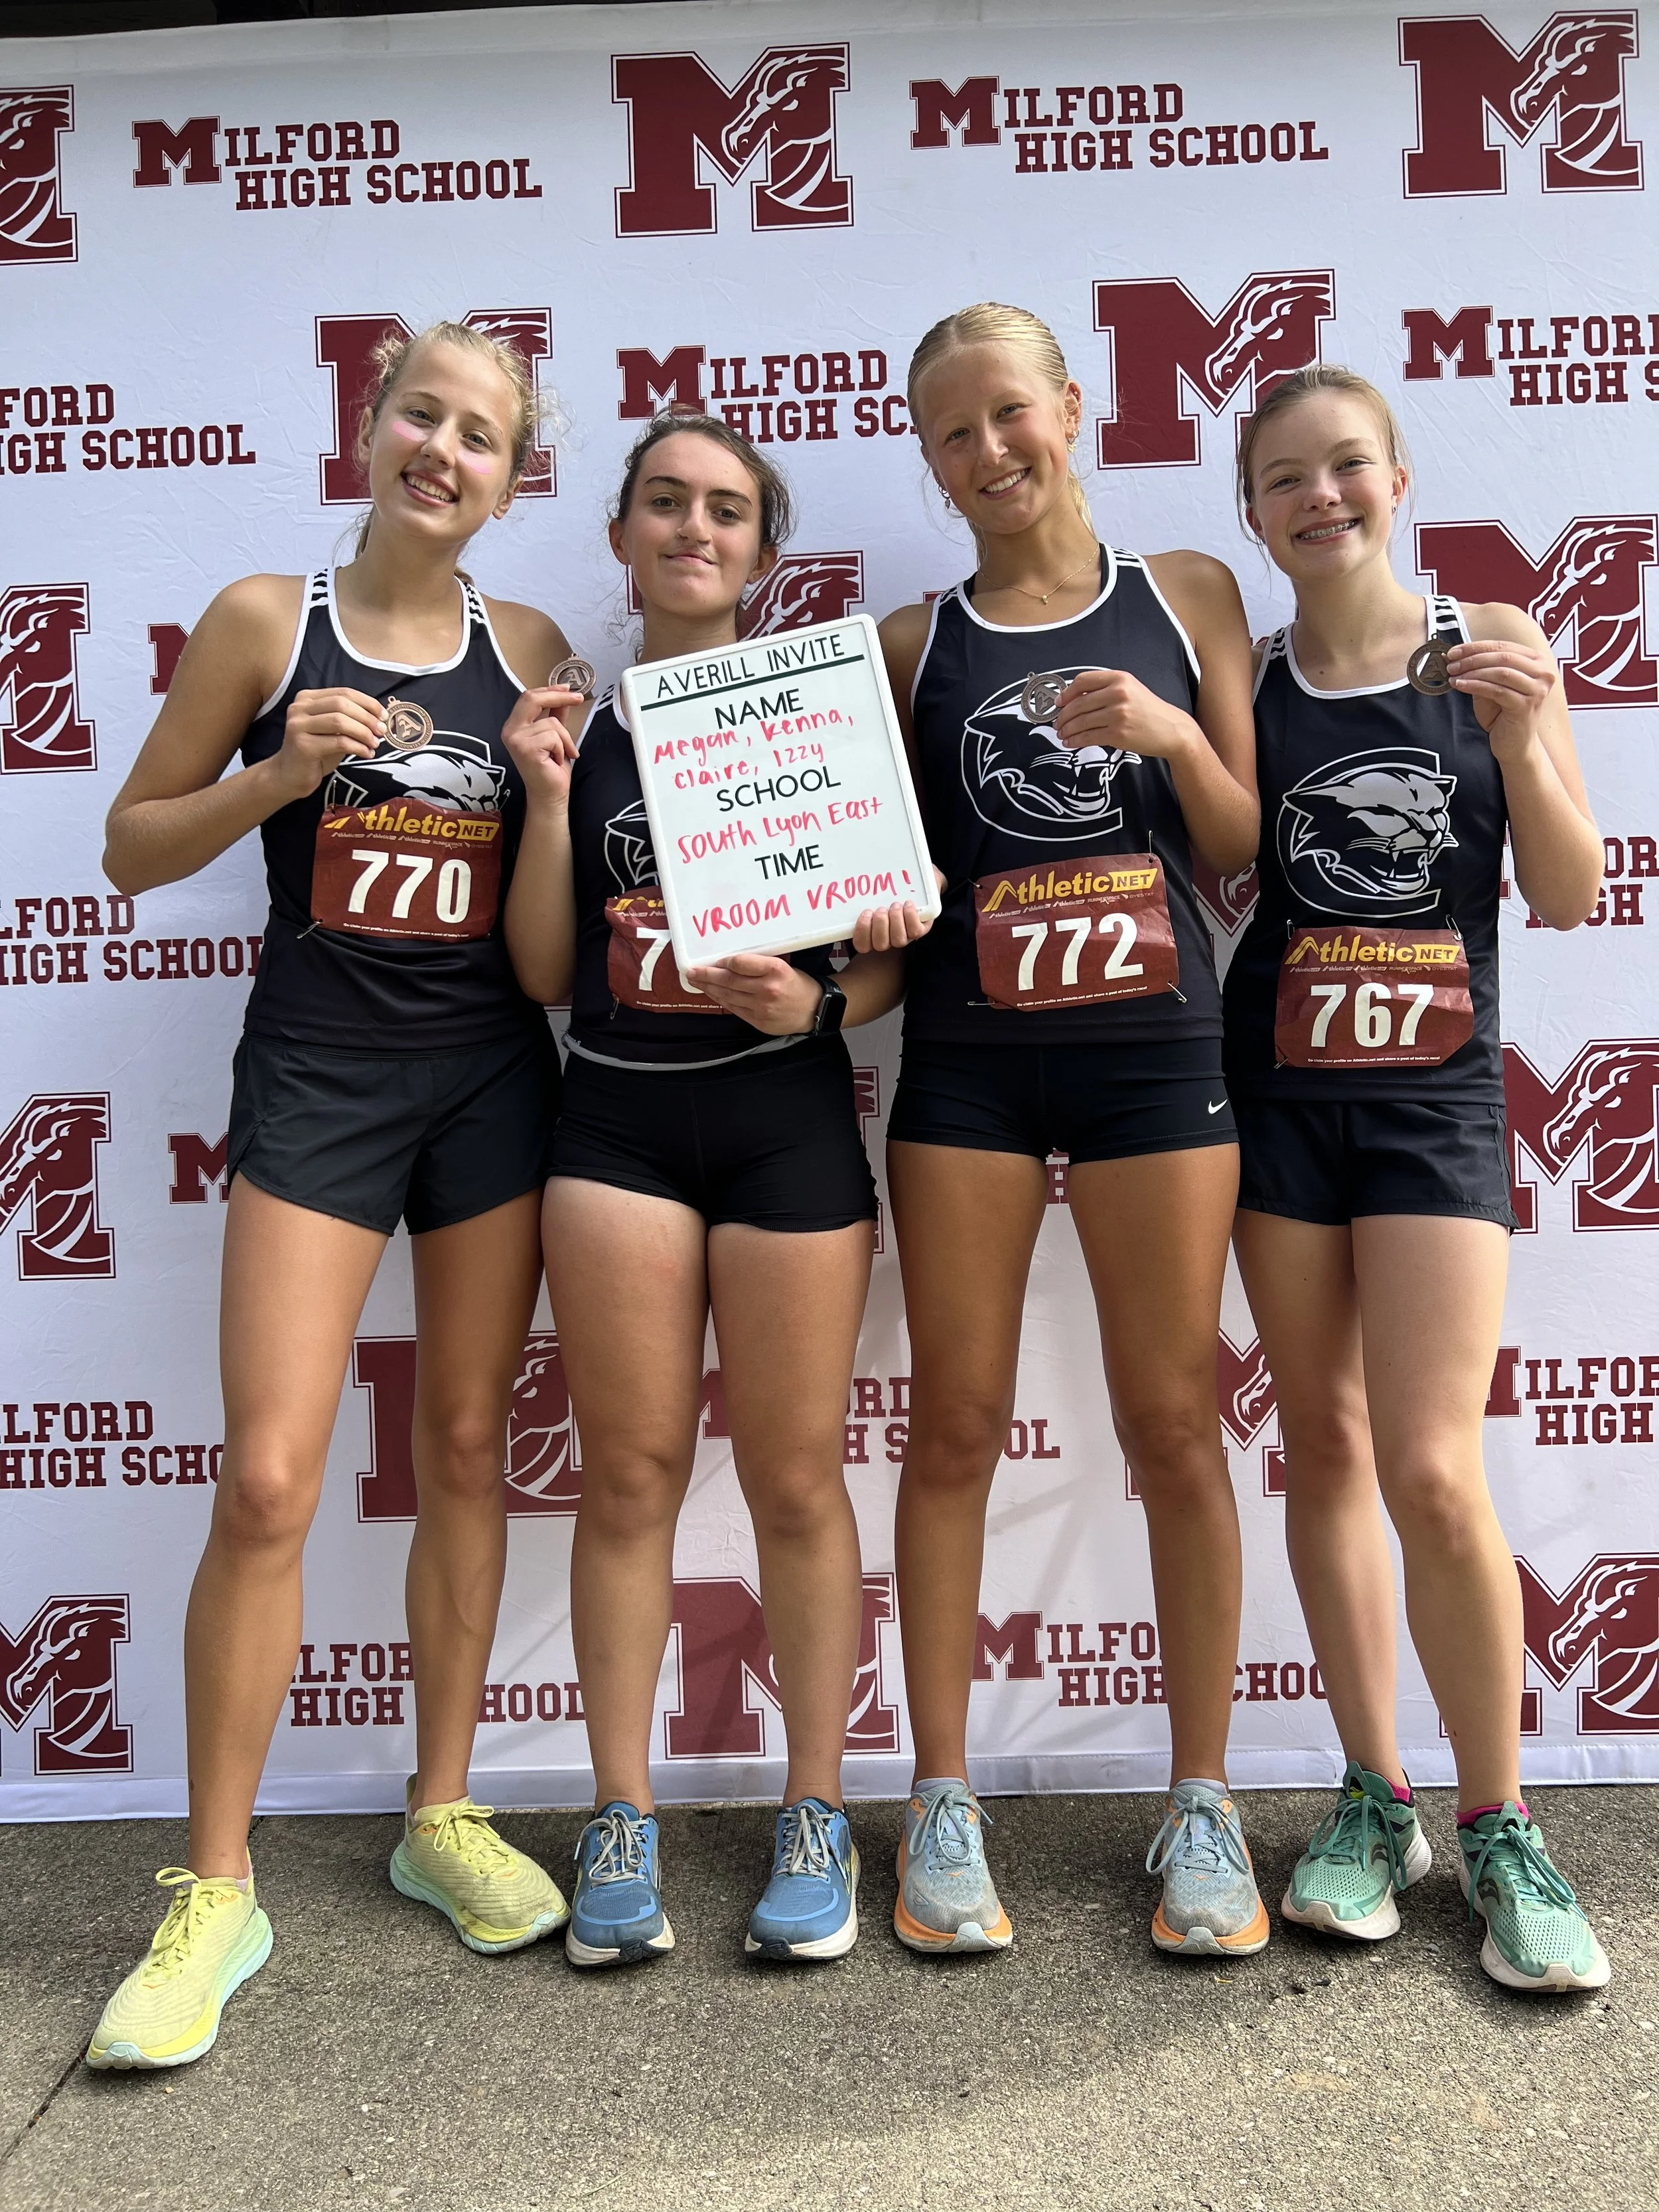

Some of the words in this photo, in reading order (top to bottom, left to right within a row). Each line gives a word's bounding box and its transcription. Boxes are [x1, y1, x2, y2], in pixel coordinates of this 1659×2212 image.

[909, 76, 1184, 150] MILFORD
[132, 115, 401, 188] MILFORD
[1015, 130, 1133, 174] HIGH
[1149, 121, 1329, 169] SCHOOL
[235, 166, 351, 210] HIGH
[367, 159, 543, 204] SCHOOL
[616, 345, 888, 420] MILFORD
[1508, 361, 1629, 406] HIGH
[721, 398, 838, 443] HIGH
[82, 423, 256, 471] SCHOOL
[657, 657, 755, 698] AVERILL
[766, 634, 845, 672] INVITE
[715, 688, 804, 729] NAME
[717, 766, 841, 812] SCHOOL
[763, 811, 822, 847] Lyon
[828, 796, 883, 825] East
[347, 849, 472, 924] 770
[755, 844, 824, 880] TIME
[692, 894, 791, 938] VROOM
[1011, 912, 1143, 992] 772
[1310, 982, 1434, 1048] 767
[1535, 1402, 1654, 1446] HIGH
[0, 1447, 107, 1489] HIGH
[972, 1611, 1163, 1681] MILFO
[290, 1687, 404, 1727] HIGH
[1058, 1666, 1168, 1707] HIGH
